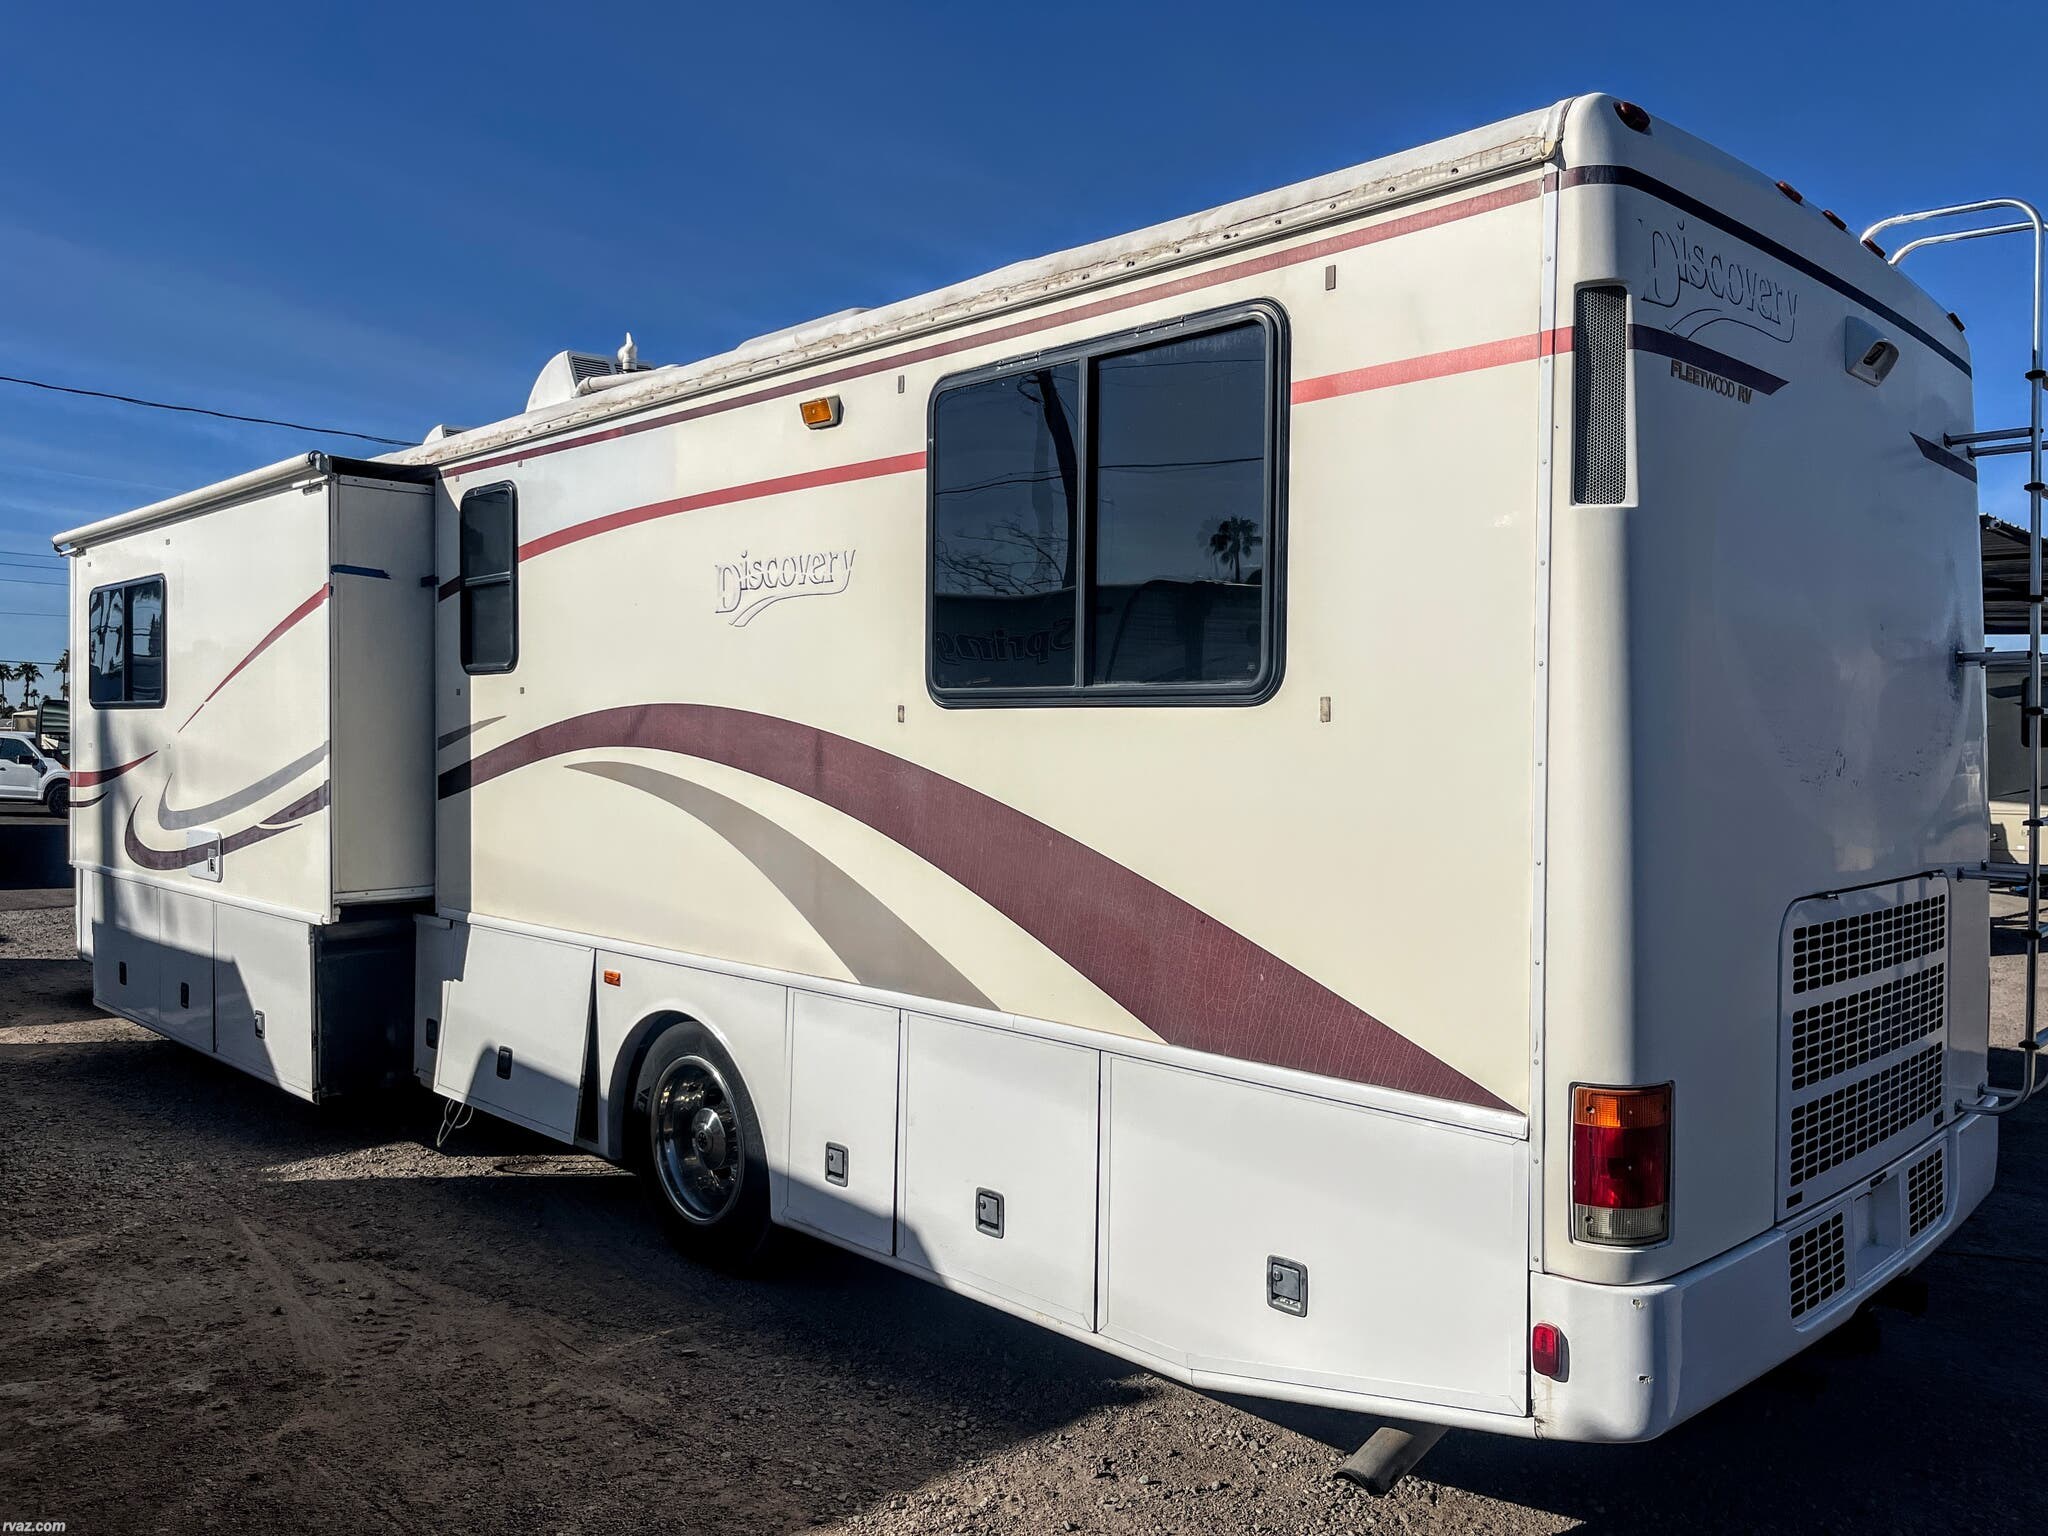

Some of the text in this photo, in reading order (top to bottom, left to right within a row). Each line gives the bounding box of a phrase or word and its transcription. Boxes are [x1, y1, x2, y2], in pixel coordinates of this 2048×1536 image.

[1639, 218, 1798, 342] Discovery
[1670, 359, 1753, 405] FLEETWOOD RV
[713, 548, 857, 627] Discovery
